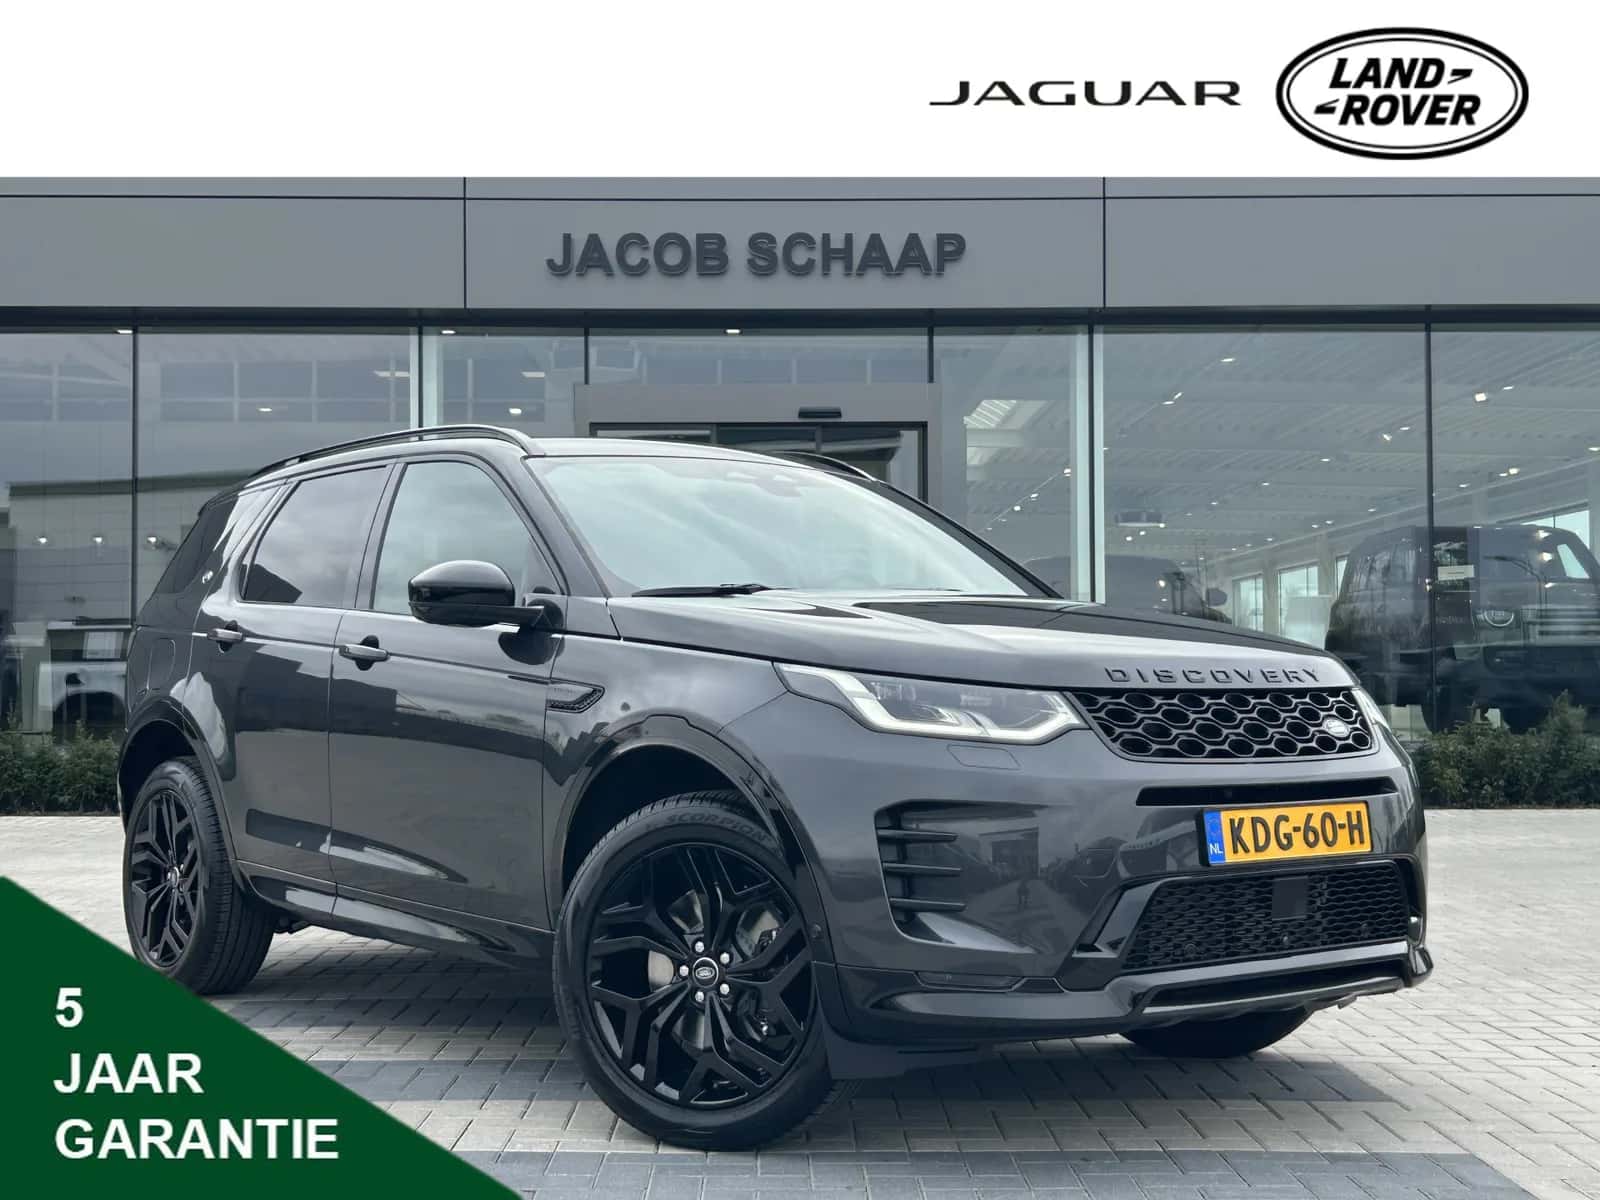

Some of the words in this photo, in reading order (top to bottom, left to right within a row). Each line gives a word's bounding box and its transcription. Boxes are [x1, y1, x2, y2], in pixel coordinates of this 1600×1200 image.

[546, 232, 729, 277] JACOB
[746, 232, 967, 277] SCHAAP
[1104, 667, 1321, 684] DISCOVERY
[1228, 810, 1366, 855] KDG-60-H
[1209, 842, 1225, 856] NL
